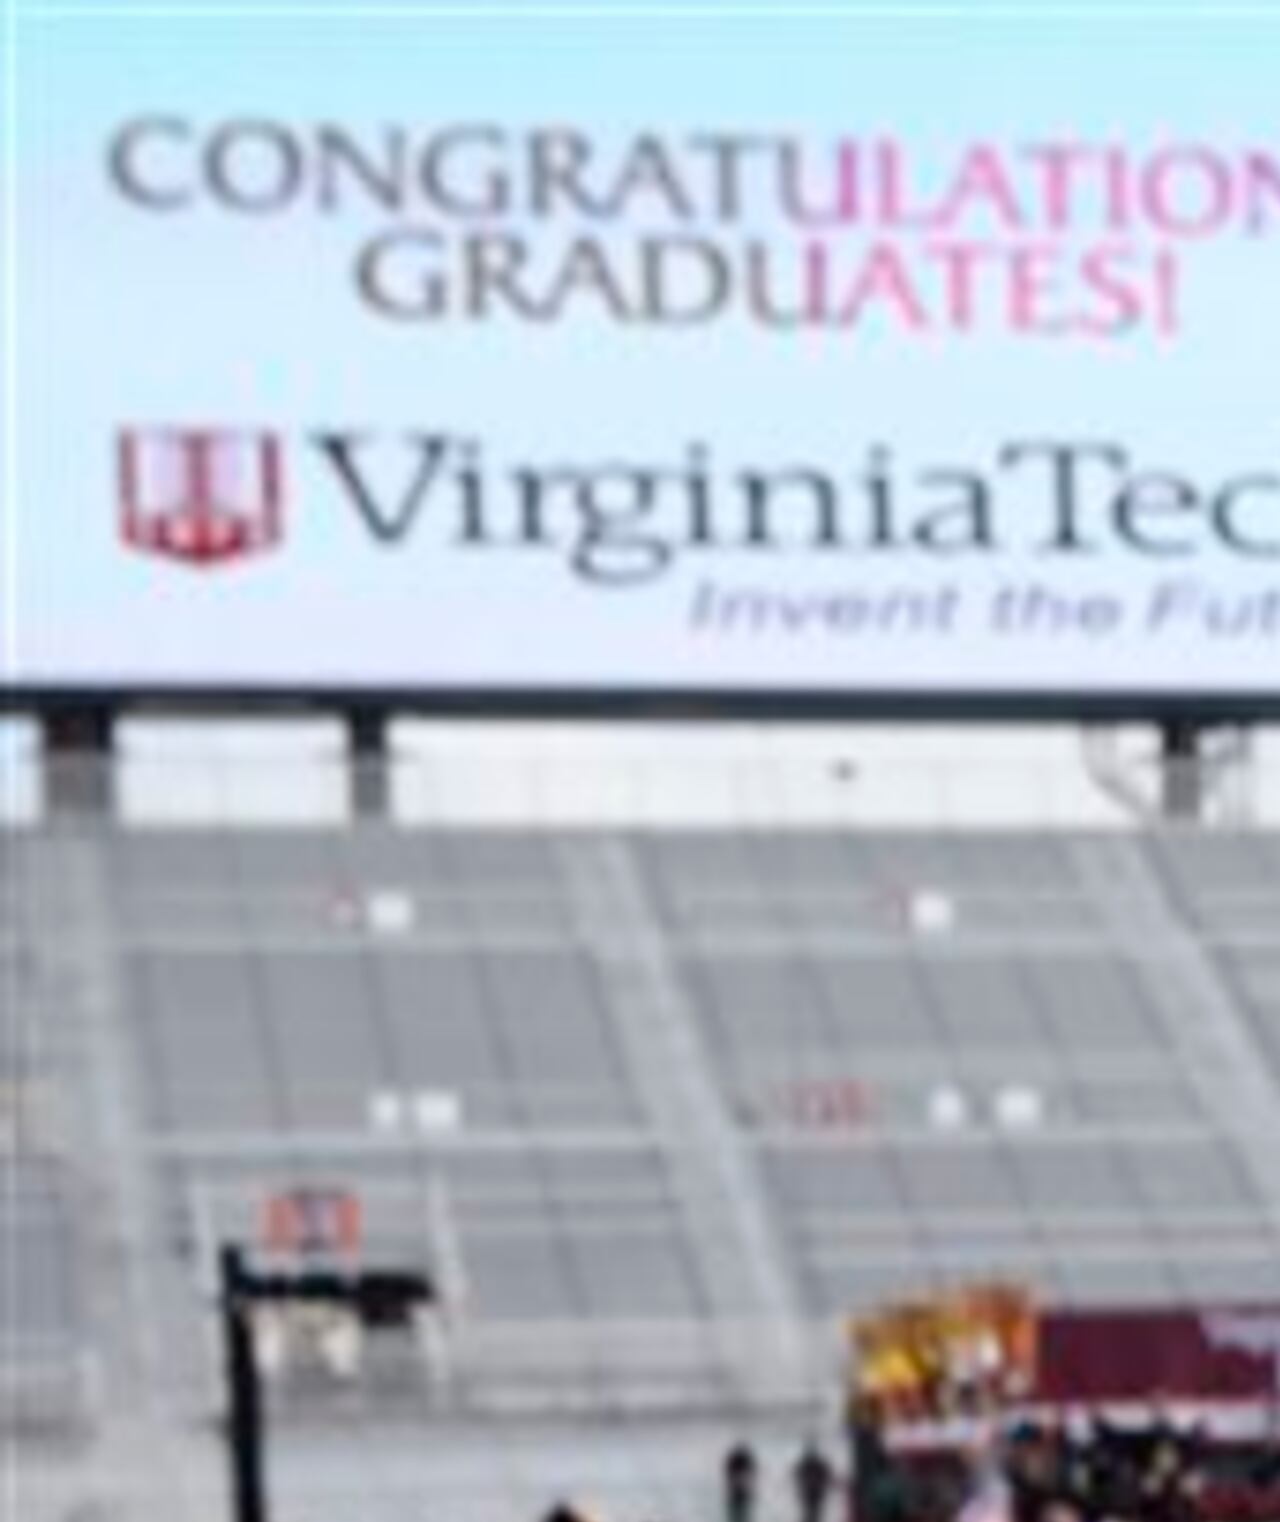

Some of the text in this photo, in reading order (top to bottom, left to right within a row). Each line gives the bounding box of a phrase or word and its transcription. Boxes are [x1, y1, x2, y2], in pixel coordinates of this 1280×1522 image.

[353, 226, 1181, 338] GRADUATES!
[690, 580, 962, 637] Invent
[990, 583, 1125, 637] the
